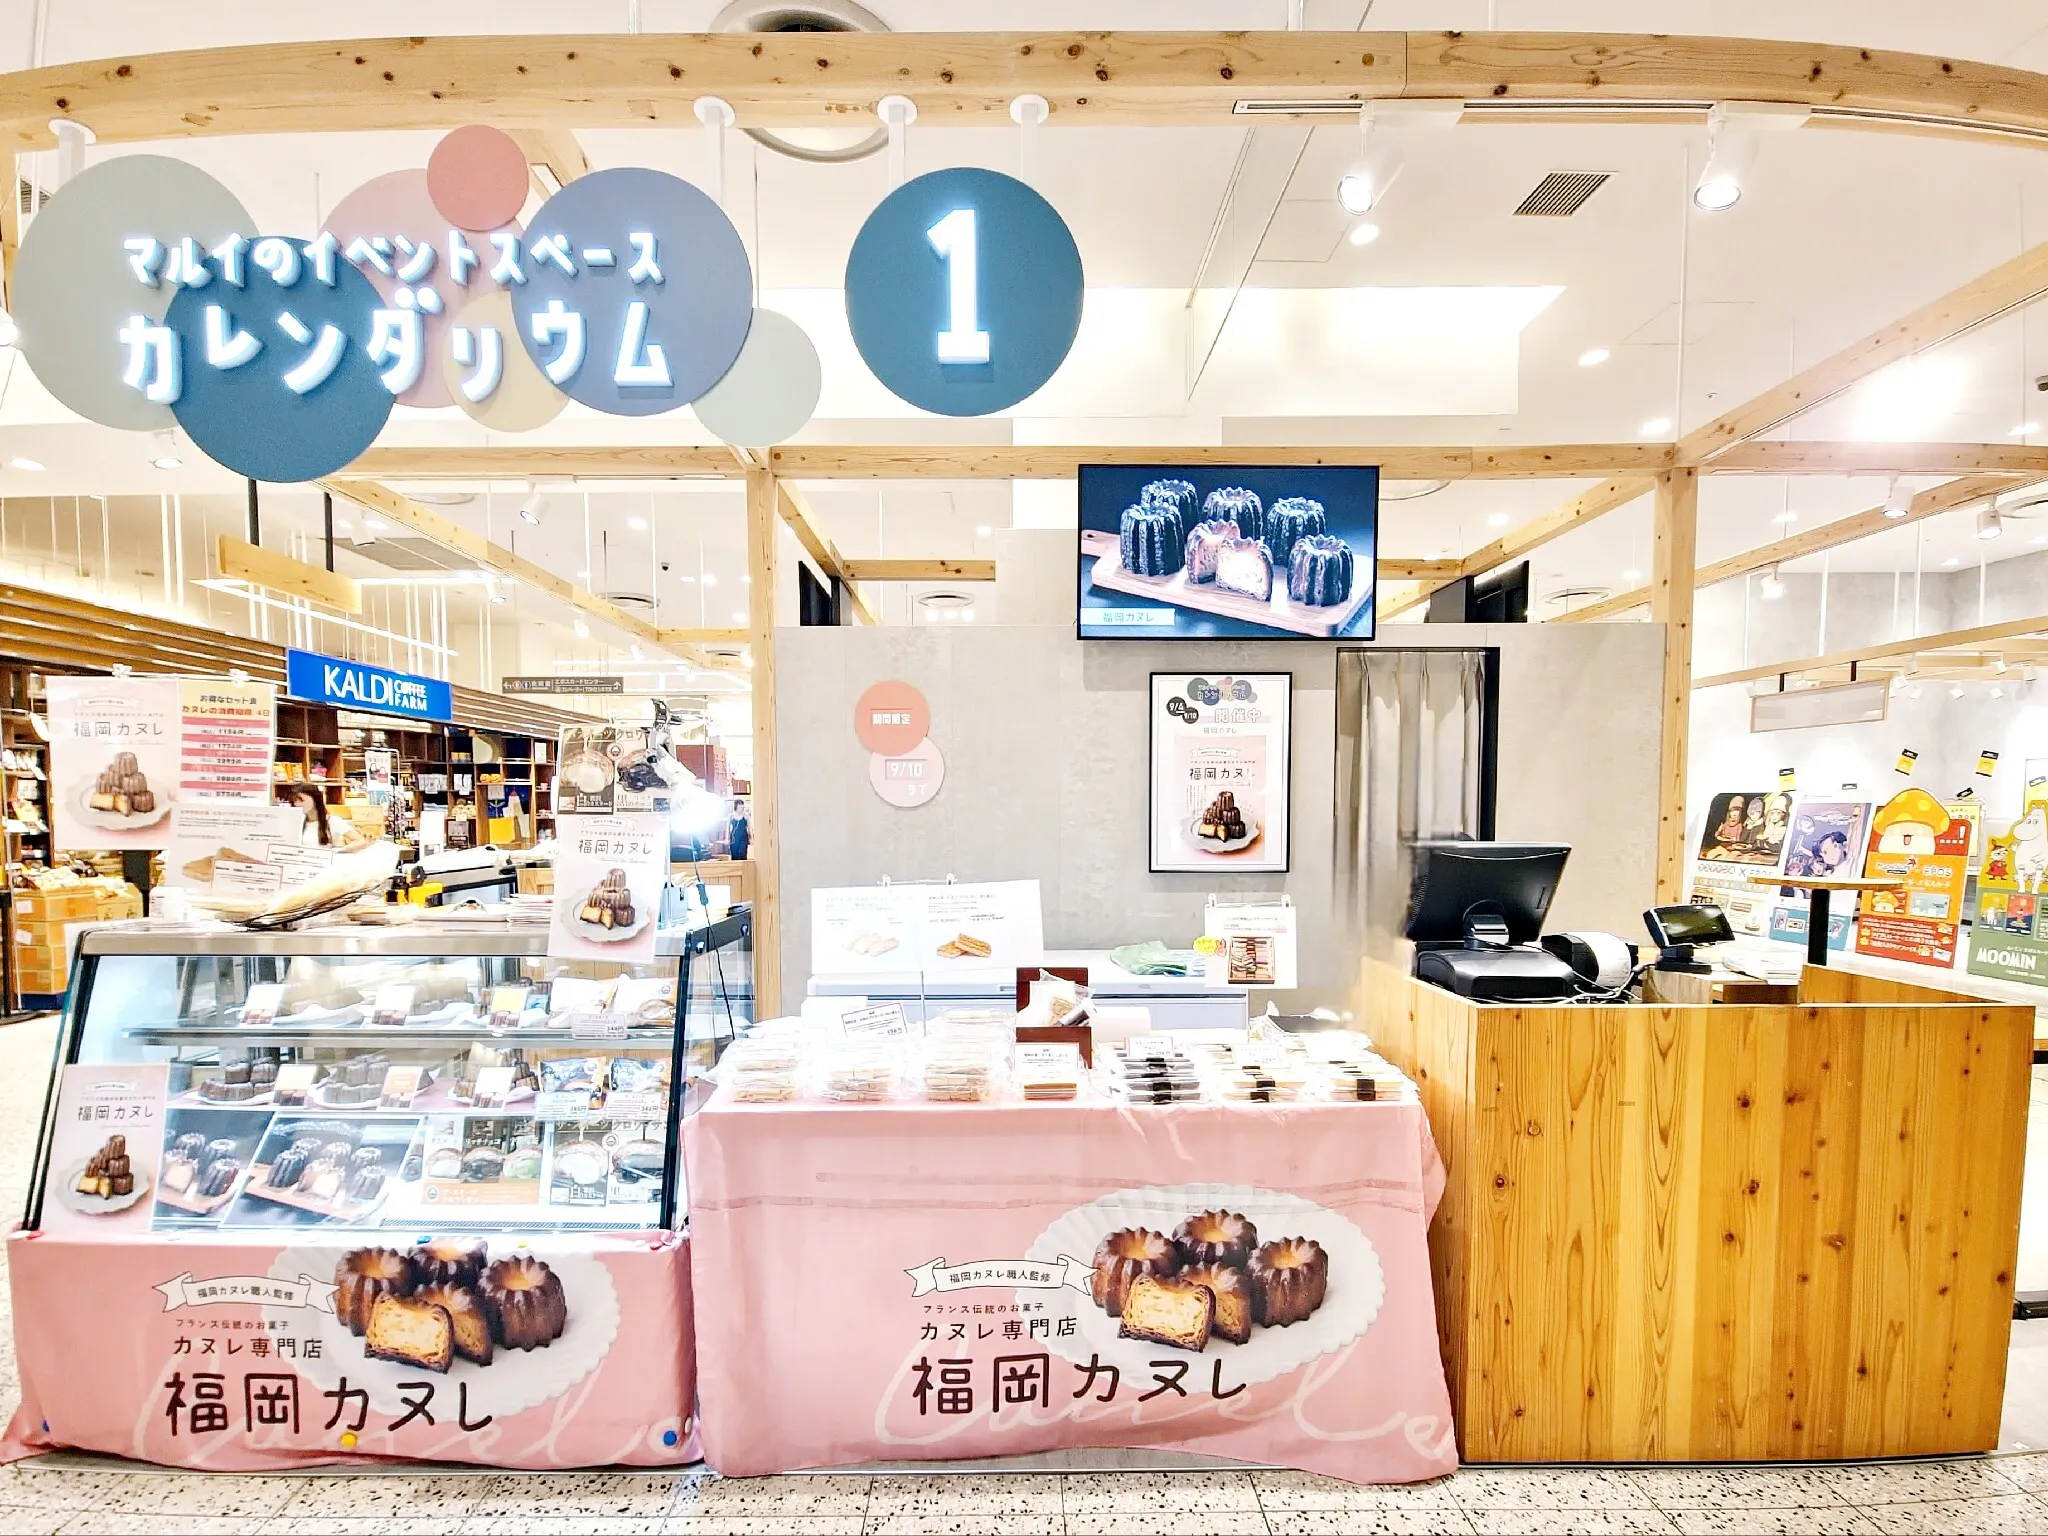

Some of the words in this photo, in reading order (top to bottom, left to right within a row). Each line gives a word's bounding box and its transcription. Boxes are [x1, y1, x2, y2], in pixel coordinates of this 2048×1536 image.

[123, 230, 665, 288] マルイのイベントスペース
[926, 208, 990, 364] 1
[119, 284, 675, 405] カレンダリウム
[324, 664, 395, 706] KALDI
[394, 679, 427, 699] COFFEE
[394, 694, 428, 712] FARM
[1215, 708, 1262, 723] 開催中
[74, 721, 164, 737] 福岡カヌレ
[890, 762, 923, 777] 9/10
[579, 839, 652, 855] 福岡カヌレ
[1976, 947, 2037, 970] MOOMIN
[78, 1105, 153, 1121] 福岡カヌレ
[952, 1269, 1051, 1284] 福岡カヌレ職人監修
[197, 1285, 294, 1301] 福岡カヌレ職人監修
[923, 1302, 1044, 1314] フランス伝統のお菓子
[175, 1319, 290, 1331] フランス伝統のお菓子
[920, 1316, 1078, 1341] カヌレ専門店
[173, 1335, 323, 1359] カヌレ専門店
[911, 1352, 1247, 1416] 福岡カヌレ
[163, 1371, 494, 1437] 福岡カヌレ
